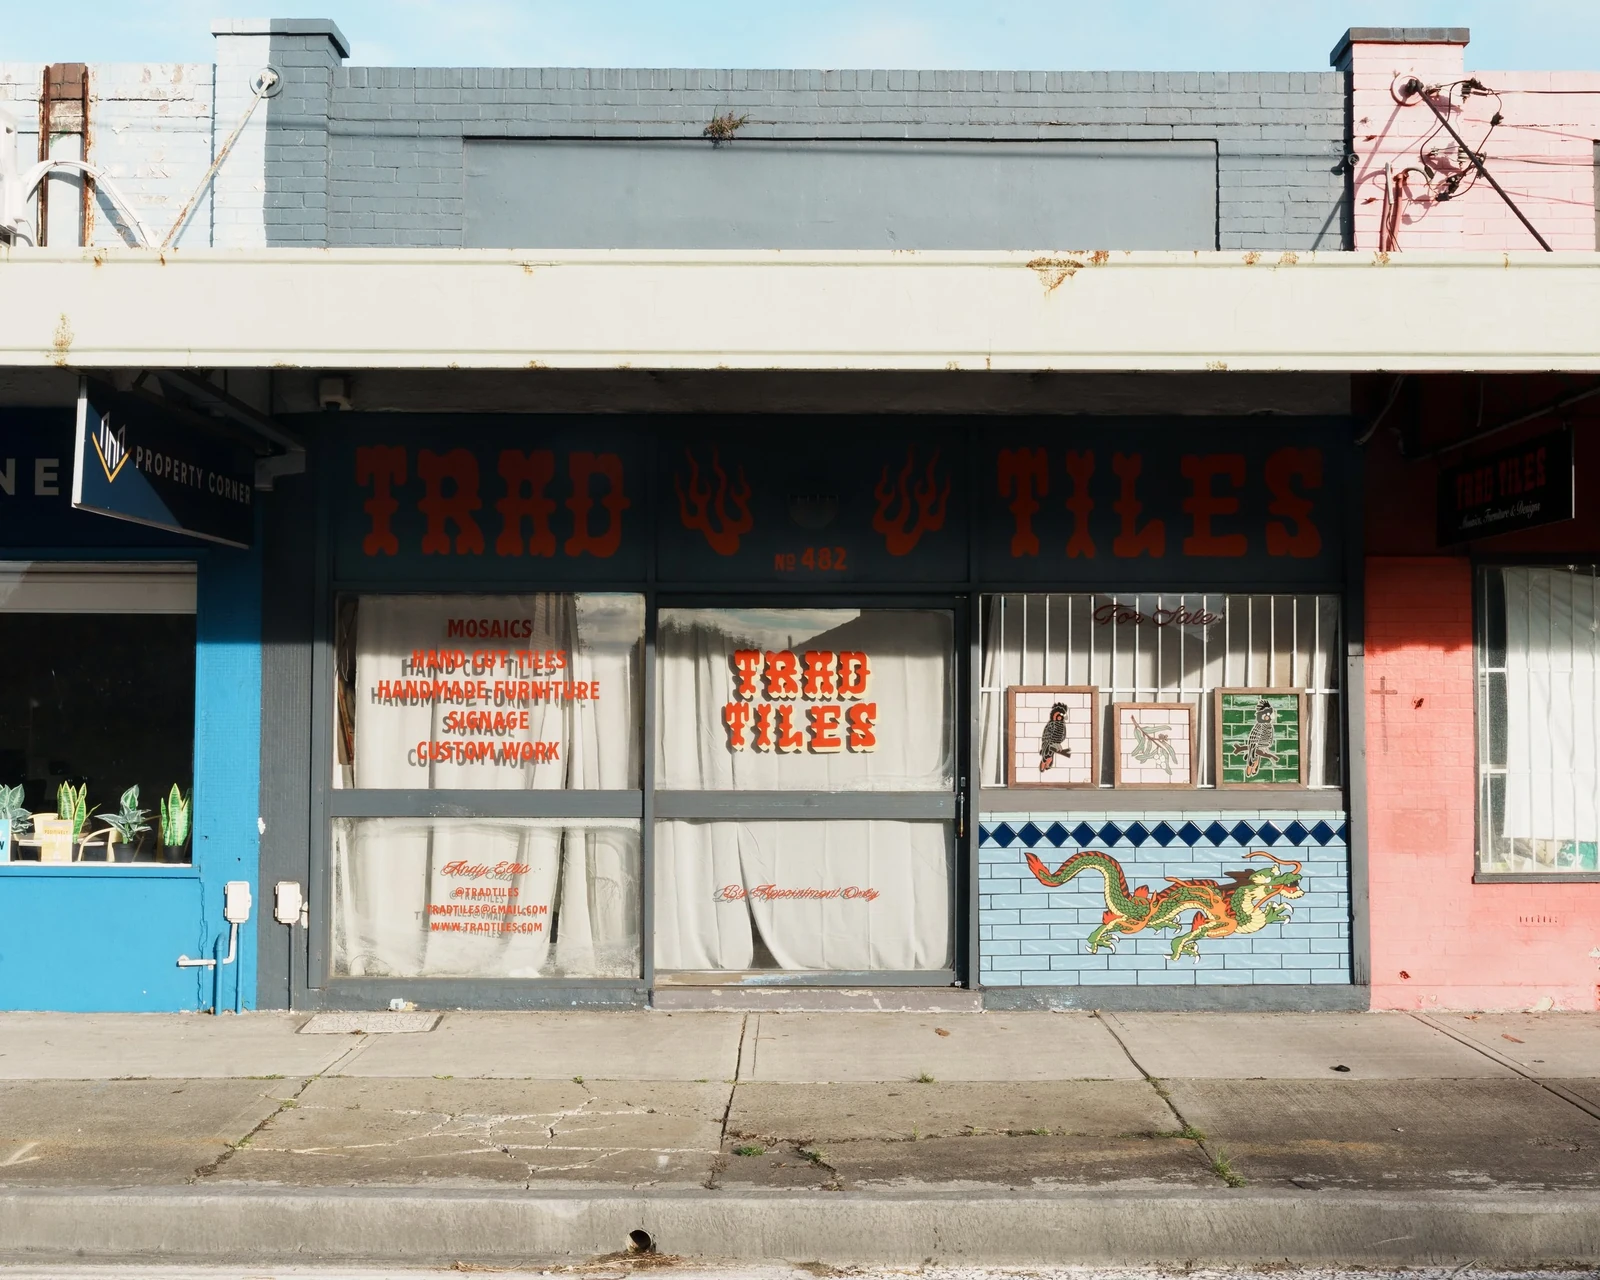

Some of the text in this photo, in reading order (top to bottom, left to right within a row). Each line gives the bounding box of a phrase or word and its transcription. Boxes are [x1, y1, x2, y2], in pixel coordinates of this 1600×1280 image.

[135, 445, 251, 504] PROPERTY CORNER
[355, 444, 1325, 559] TRAD TILES
[801, 546, 848, 572] 482
[1094, 604, 1217, 627] For Sale
[447, 618, 532, 639] MOSAICS
[411, 649, 567, 669] HAND CUT TILES
[733, 649, 872, 699] TRAD
[377, 680, 600, 700] HANDMADE FURNITURE
[448, 710, 530, 730] SIGNAGE
[725, 701, 879, 752] TILES
[416, 741, 560, 761] CUSTOM WORK
[442, 860, 531, 877] Andy Ellis
[455, 887, 519, 897] @TRADTILES
[723, 884, 880, 902] By Appointment Only
[426, 905, 547, 915] TRADTILES@GMAIL.COM
[431, 922, 542, 932] WWW.TRADTILES.COM
